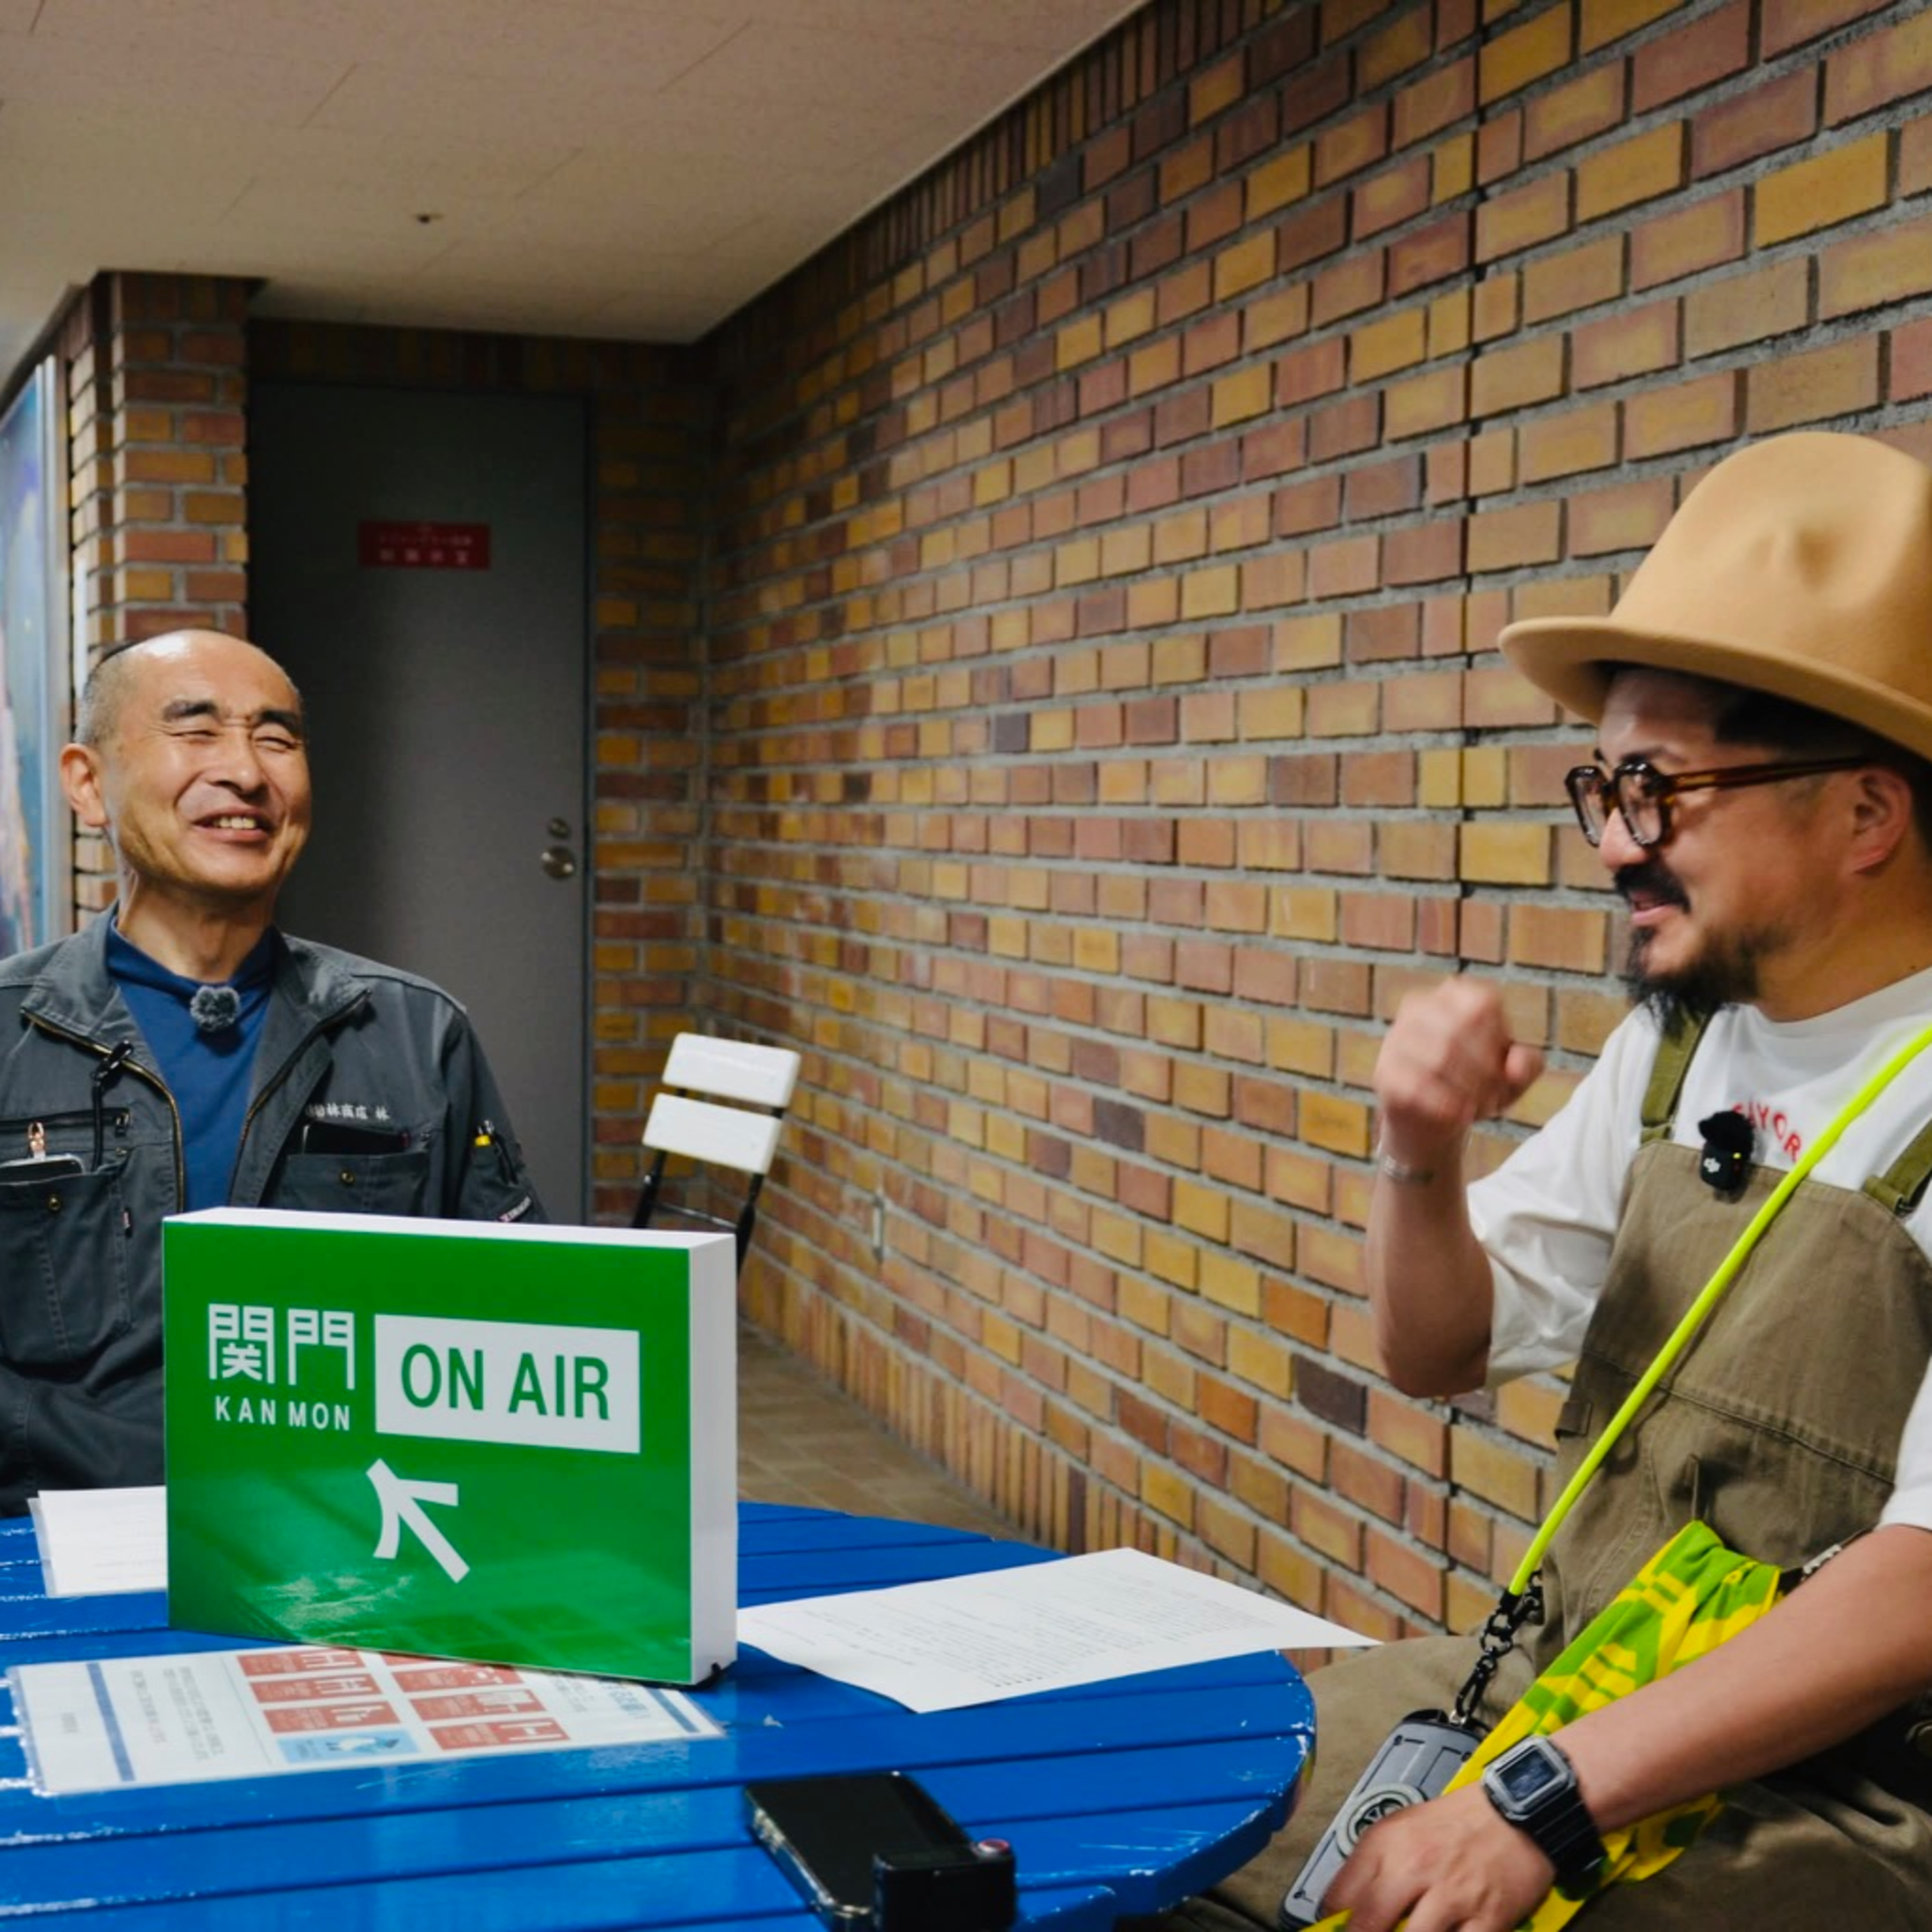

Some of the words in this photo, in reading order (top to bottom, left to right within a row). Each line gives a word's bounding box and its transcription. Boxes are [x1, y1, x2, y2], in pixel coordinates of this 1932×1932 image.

[209, 1303, 355, 1390] 関門
[401, 1343, 484, 1411] ON
[507, 1352, 610, 1421] AIR
[215, 1395, 276, 1425] KAN
[289, 1401, 350, 1431] MON
